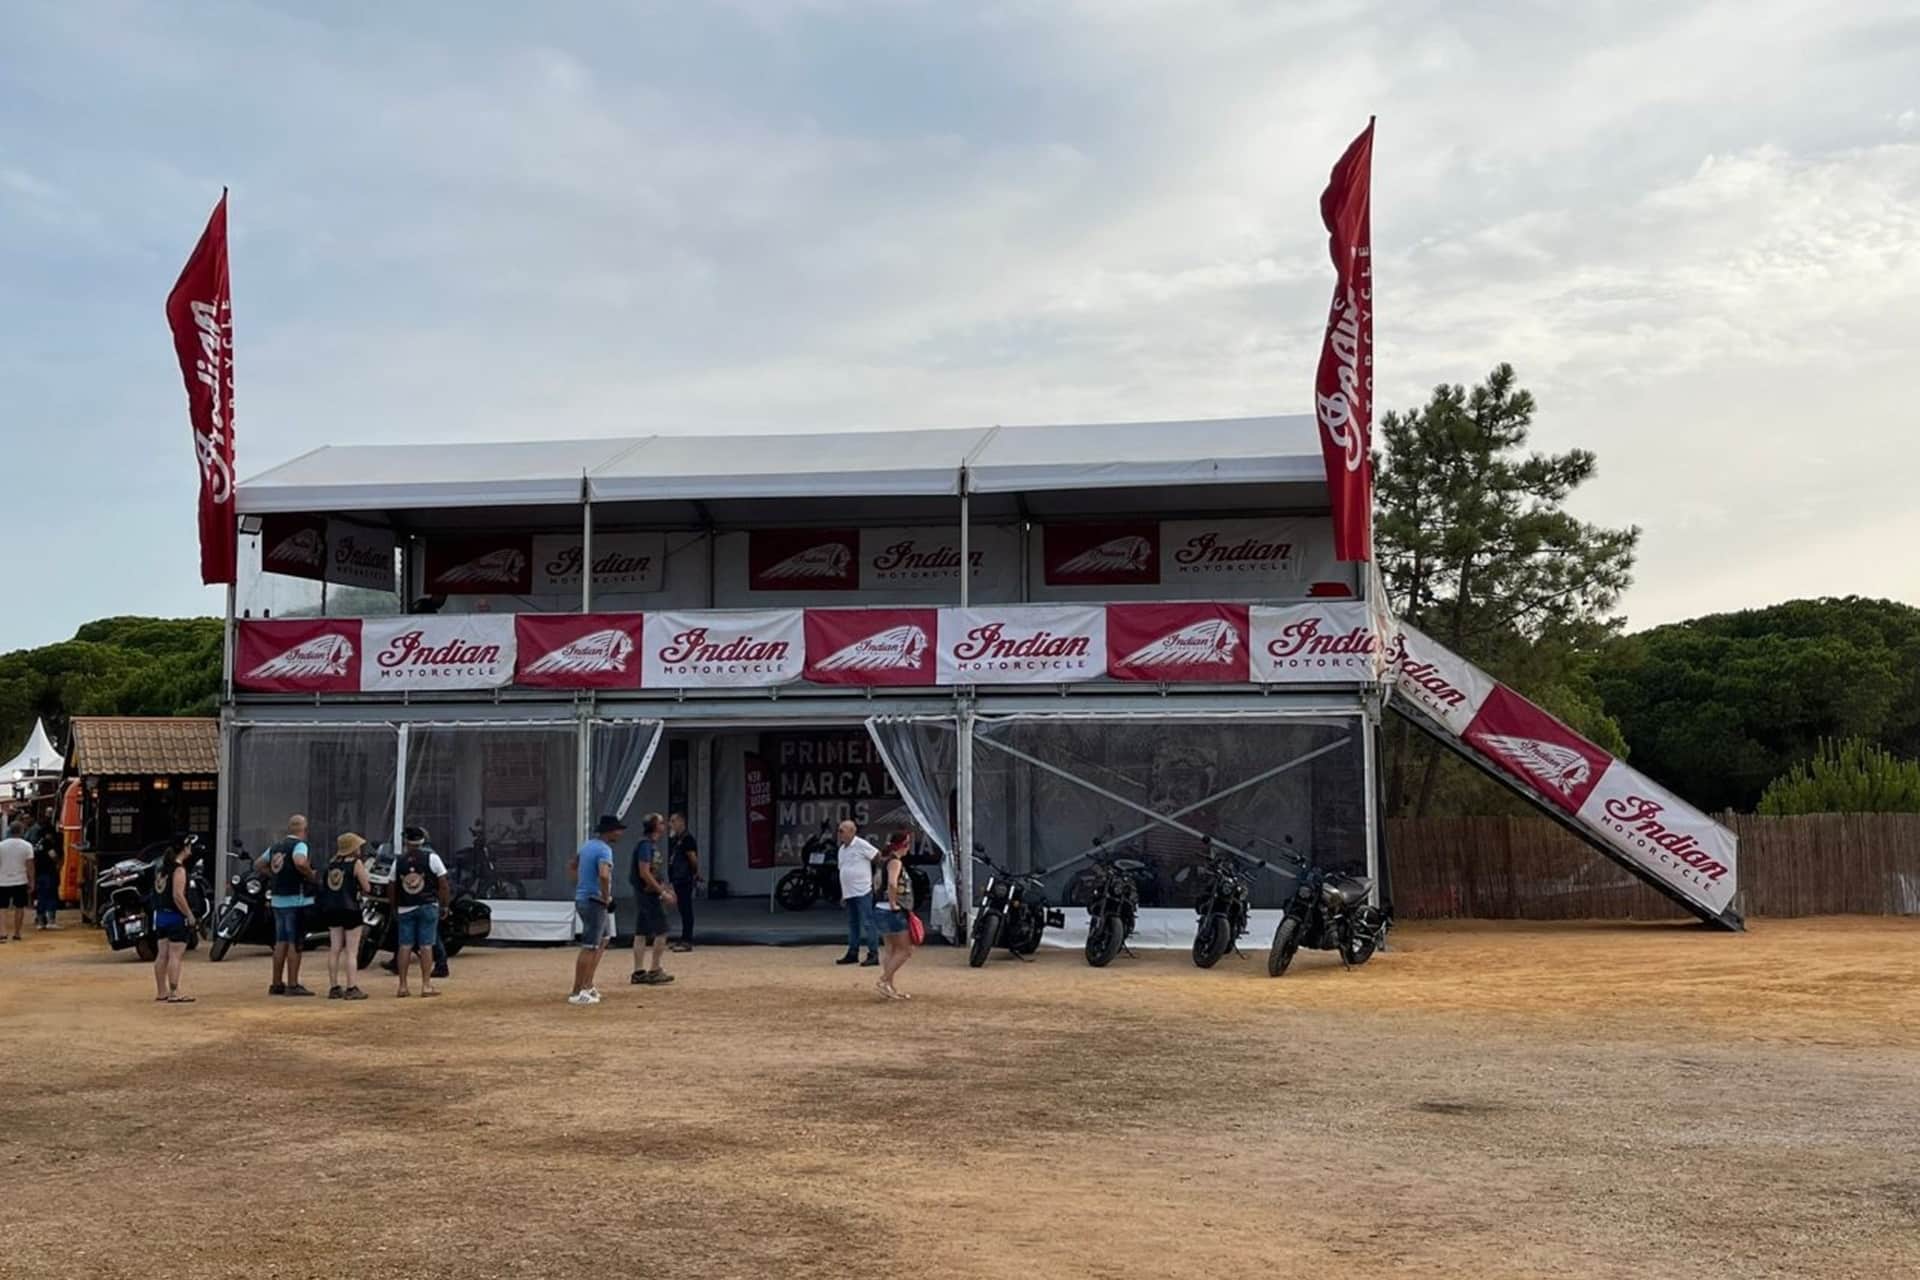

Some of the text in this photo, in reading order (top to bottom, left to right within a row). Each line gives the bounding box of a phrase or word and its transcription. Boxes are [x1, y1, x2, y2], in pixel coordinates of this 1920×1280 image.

[1174, 532, 1293, 563] Indian
[546, 546, 651, 575] Idian
[1179, 562, 1290, 573] MOTORCYCLE
[549, 575, 647, 585] MOTRCYCLE
[876, 571, 981, 579] MOTORCYCE
[377, 630, 502, 668] Indian
[658, 627, 790, 665] Indian
[953, 622, 1090, 660] Indian
[380, 665, 498, 678] MOTORCYCLE
[663, 663, 784, 675] MOTORCYCLE
[957, 659, 1086, 671] MOTORCYCLE
[780, 771, 873, 796] MARCA
[779, 801, 870, 826] MOTOS
[1604, 795, 1728, 881] Indian
[1602, 814, 1712, 893] MOTORCYCLE
